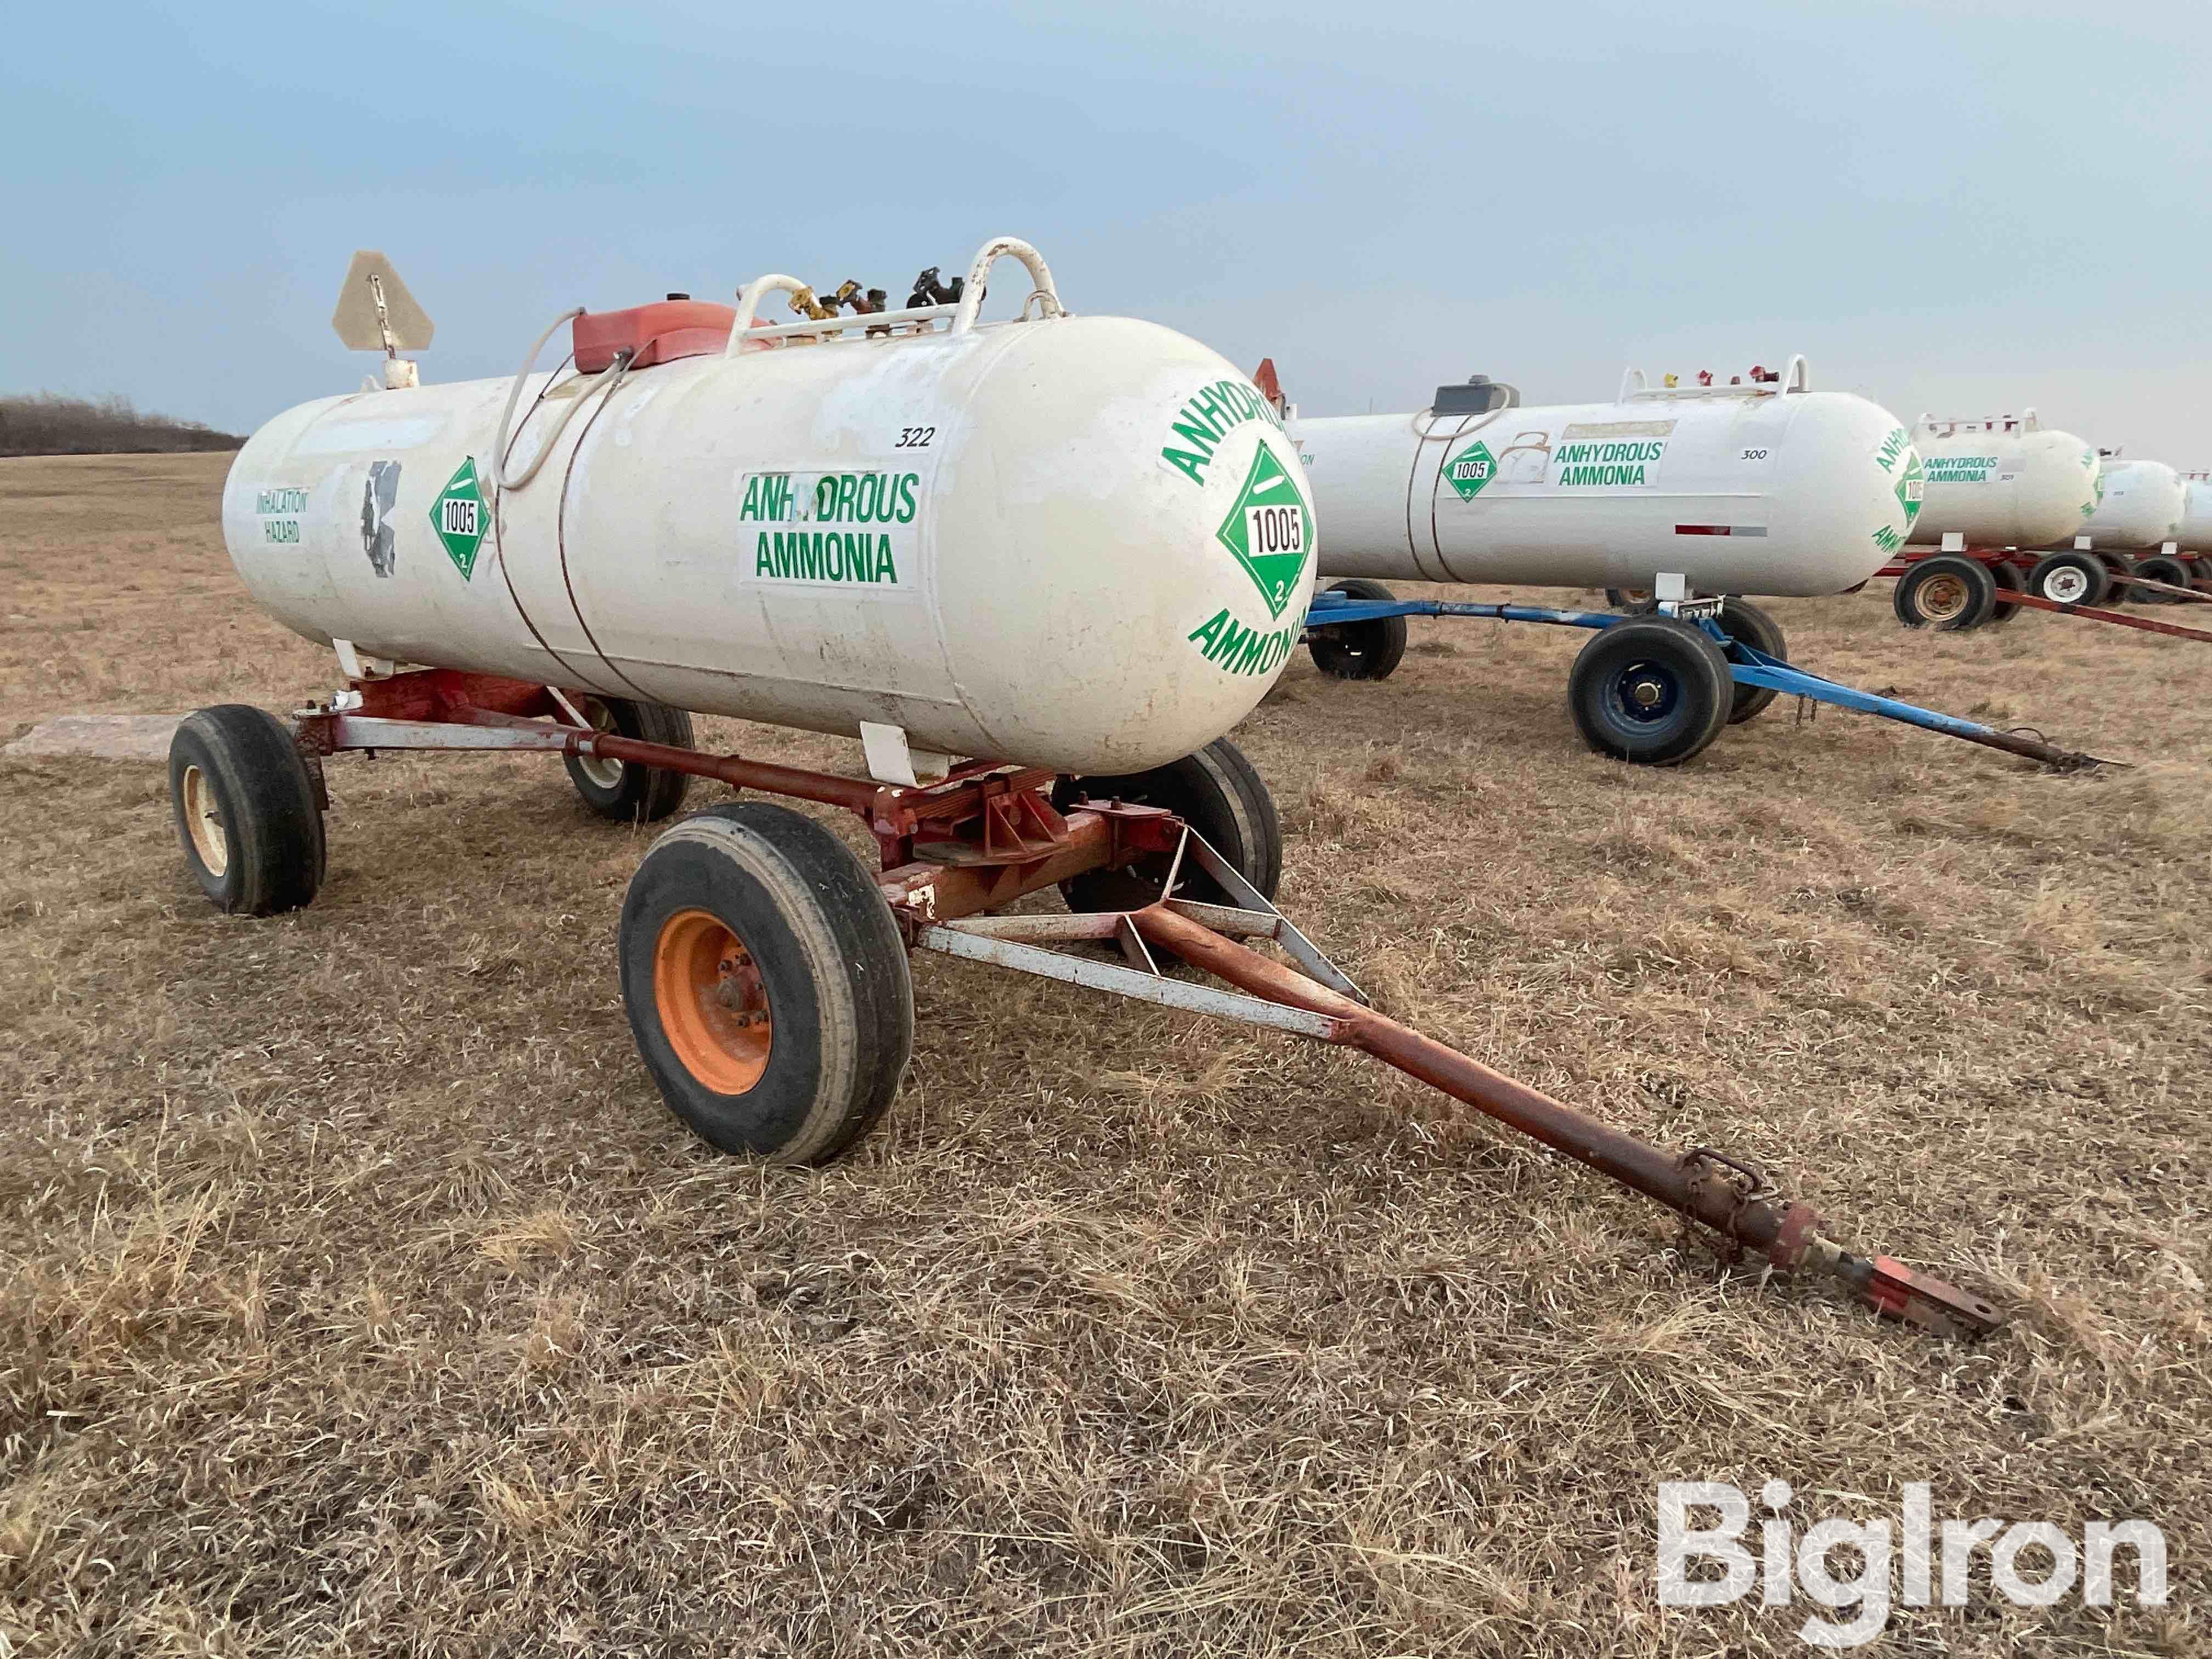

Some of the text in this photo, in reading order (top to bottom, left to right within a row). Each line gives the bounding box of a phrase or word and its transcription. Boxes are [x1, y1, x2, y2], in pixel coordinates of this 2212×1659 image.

[895, 427, 936, 448] 322
[1554, 442, 1663, 463] ANHYDROUS
[1741, 449, 1767, 460] 300
[1924, 456, 1999, 469] ANHYDROUS
[1457, 461, 1485, 478] 1005
[1559, 465, 1645, 486] AMMONIA
[1927, 470, 1987, 482] AMMONIA
[740, 473, 919, 523] ANHDROUS
[445, 501, 475, 533] 1005
[264, 520, 300, 543] HAZARD
[1253, 507, 1301, 553] 1005
[460, 554, 467, 569] 2
[756, 531, 898, 583] AMMONIA
[1275, 579, 1285, 602] 2
